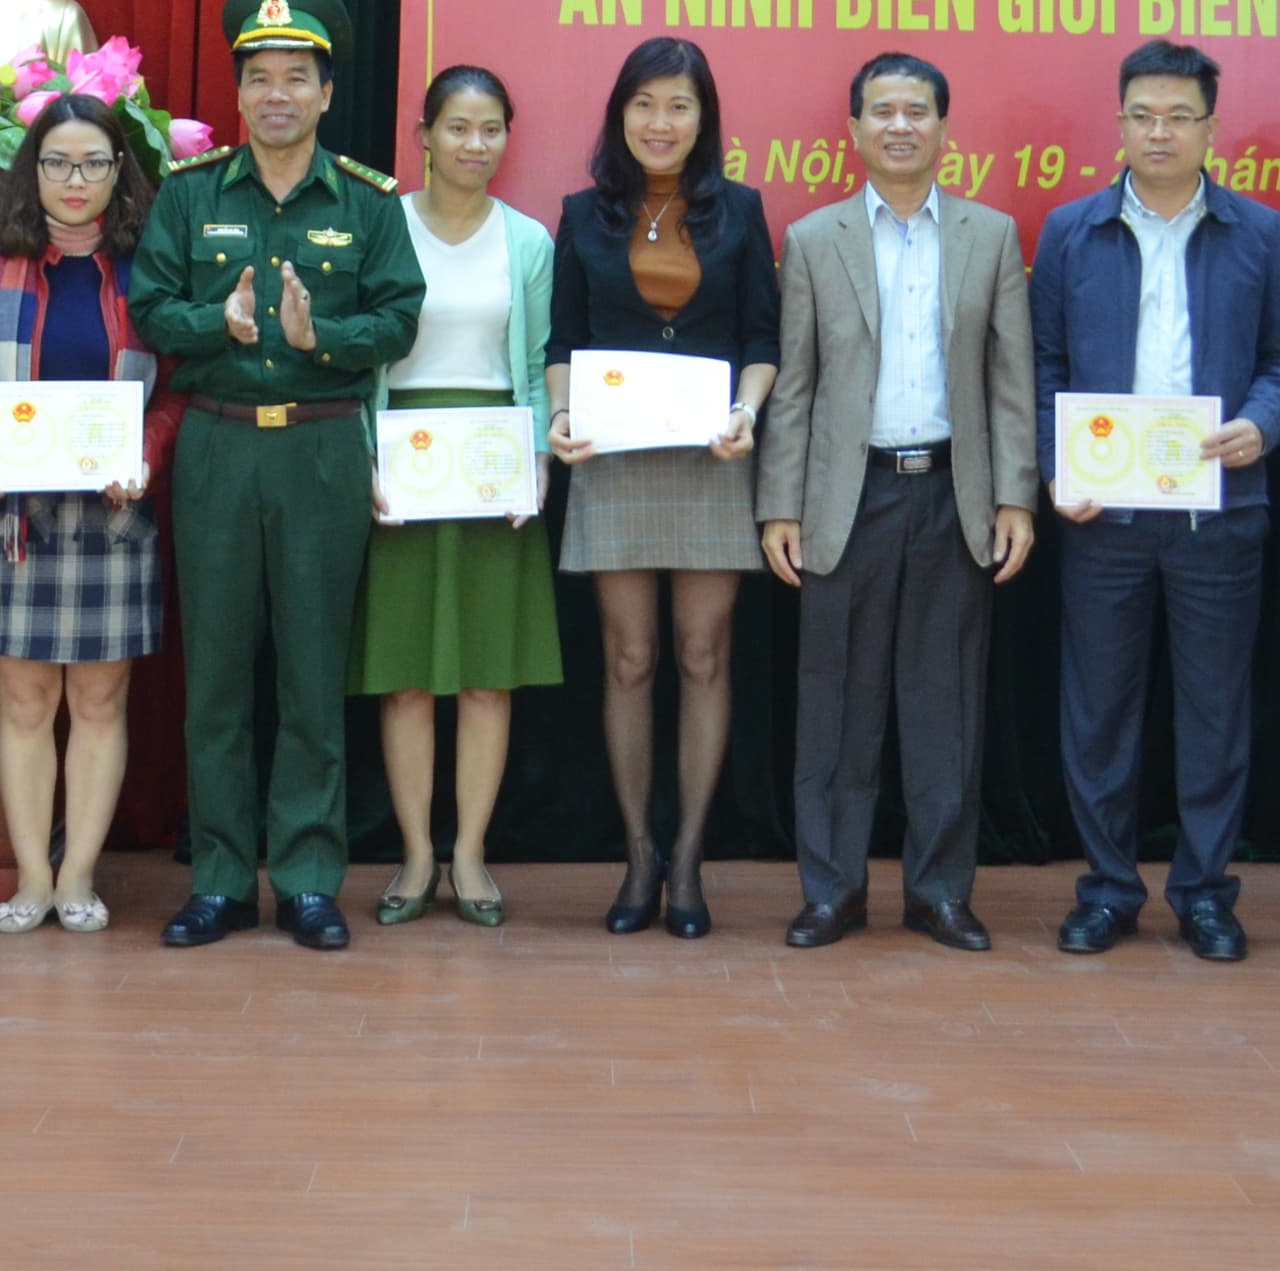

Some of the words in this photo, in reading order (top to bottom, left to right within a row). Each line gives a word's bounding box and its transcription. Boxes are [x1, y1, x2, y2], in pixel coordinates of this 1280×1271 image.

[723, 138, 748, 182] à
[765, 140, 855, 192] Nội,
[1016, 146, 1064, 188] 19
